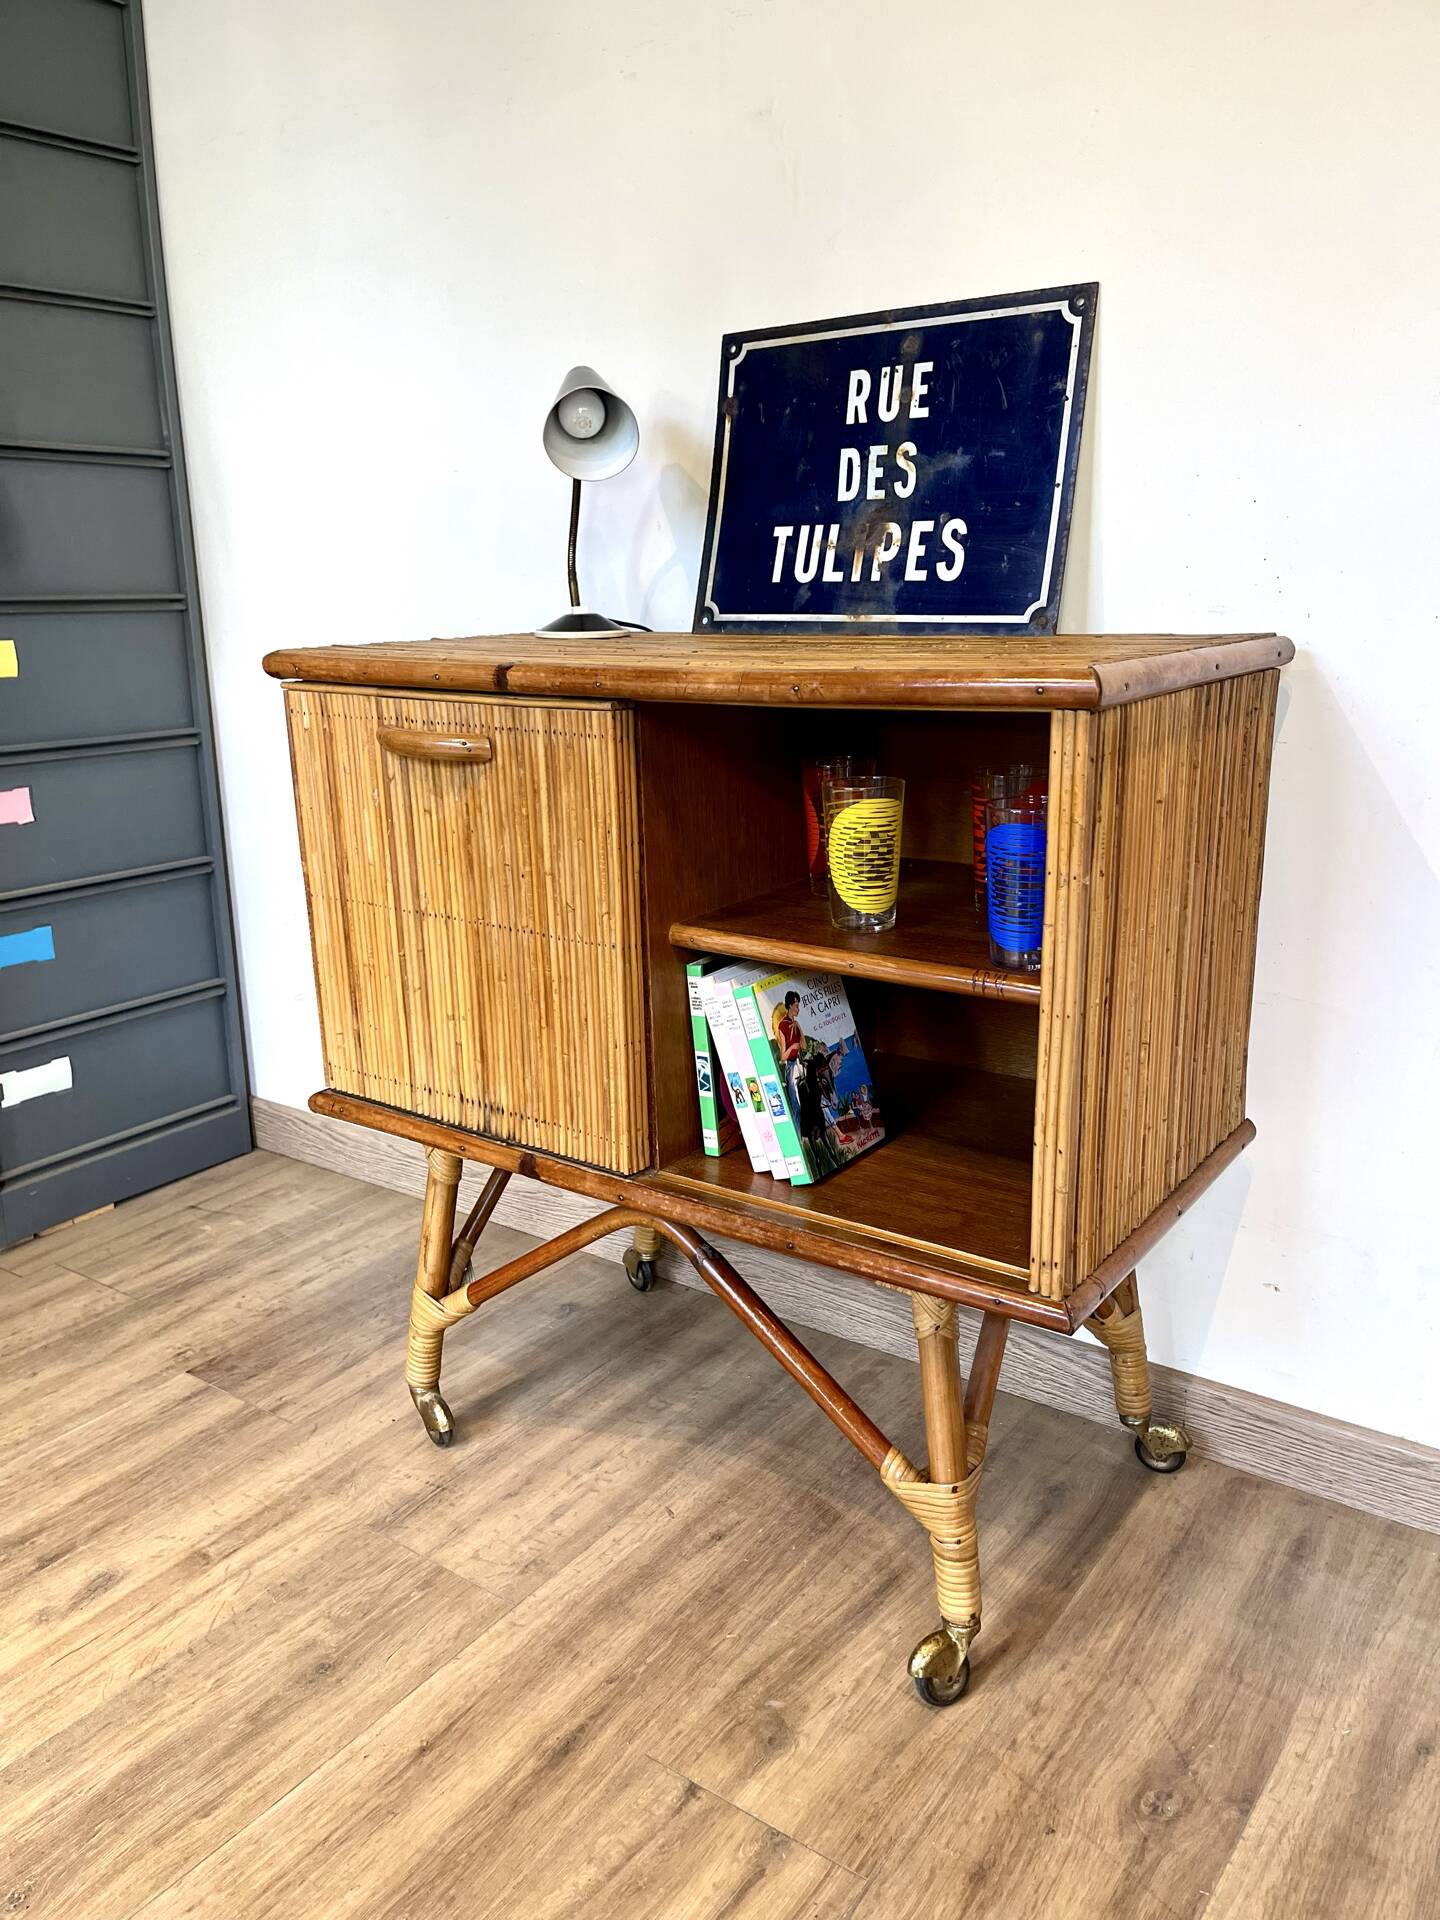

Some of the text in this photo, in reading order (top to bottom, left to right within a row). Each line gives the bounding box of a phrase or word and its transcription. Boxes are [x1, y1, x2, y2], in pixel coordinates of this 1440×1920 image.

[846, 361, 934, 425] RUE
[837, 441, 918, 502] DES
[771, 518, 968, 583] TULIPES
[801, 981, 842, 1008] JEUNES FILLES
[817, 994, 841, 1013] CAPRI
